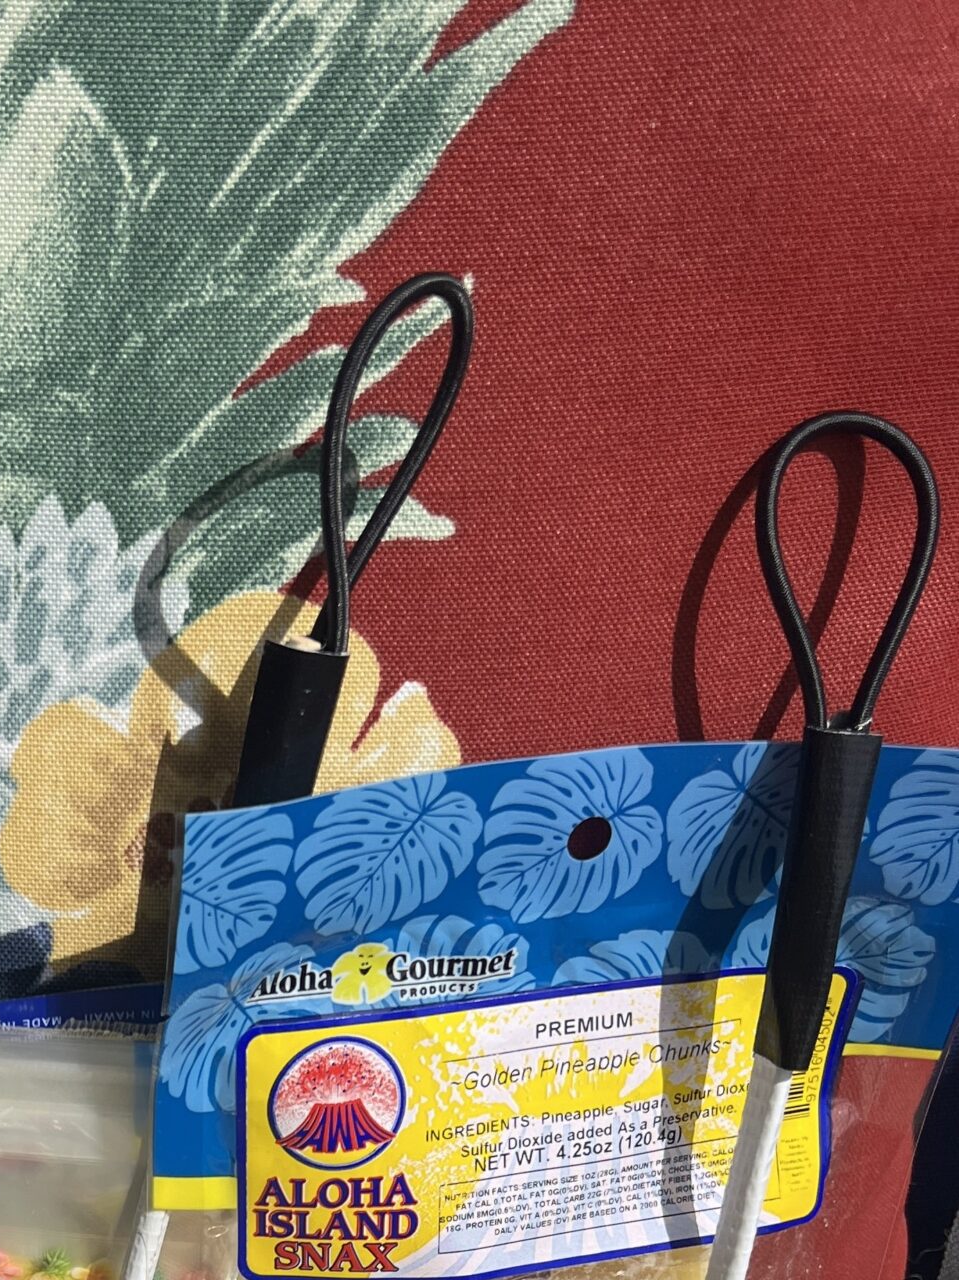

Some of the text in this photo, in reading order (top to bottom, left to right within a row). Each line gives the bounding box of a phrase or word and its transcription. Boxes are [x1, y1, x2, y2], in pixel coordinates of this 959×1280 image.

[248, 948, 516, 998] Aloha Gourmet
[400, 983, 476, 998] PRODUCTS
[23, 1016, 62, 1028] MADE
[535, 1012, 634, 1039] PREMIUM
[540, 1049, 640, 1079] Pineapple
[426, 1115, 536, 1142] INGREDIENTS:
[674, 1087, 711, 1105] Sulfur
[461, 1103, 737, 1158] Sulfur Dioxide added As a Preservative.
[475, 1126, 682, 1173] NET WT. 4.25oz (120.4g)
[560, 1174, 579, 1185] SIZE
[621, 1160, 654, 1173] AMOUNT
[656, 1157, 672, 1167] PER
[712, 1147, 734, 1157] CALO
[254, 1171, 418, 1208] ALOHA
[439, 1212, 475, 1223] SODIUM
[534, 1198, 561, 1209] TOTAL
[563, 1193, 585, 1204] CARB
[669, 1173, 692, 1184] FIBER
[455, 1202, 472, 1211] FAT
[474, 1199, 491, 1208] CAL
[530, 1189, 546, 1199] FAT
[610, 1175, 626, 1184] FAT
[465, 1218, 503, 1230] PROTEIN
[519, 1212, 532, 1220] VIT
[573, 1202, 586, 1212] VIT
[626, 1192, 642, 1201] CAL
[675, 1184, 694, 1194] IRON
[252, 1208, 420, 1241] ISLAND
[494, 1225, 518, 1236] DAILY
[520, 1219, 552, 1231] VALUES
[572, 1212, 587, 1221] ARE
[589, 1207, 617, 1218] BASED
[618, 1205, 631, 1213] ON
[660, 1194, 694, 1206] CALORIE
[696, 1191, 716, 1201] DIET
[274, 1241, 400, 1273] SNAX
